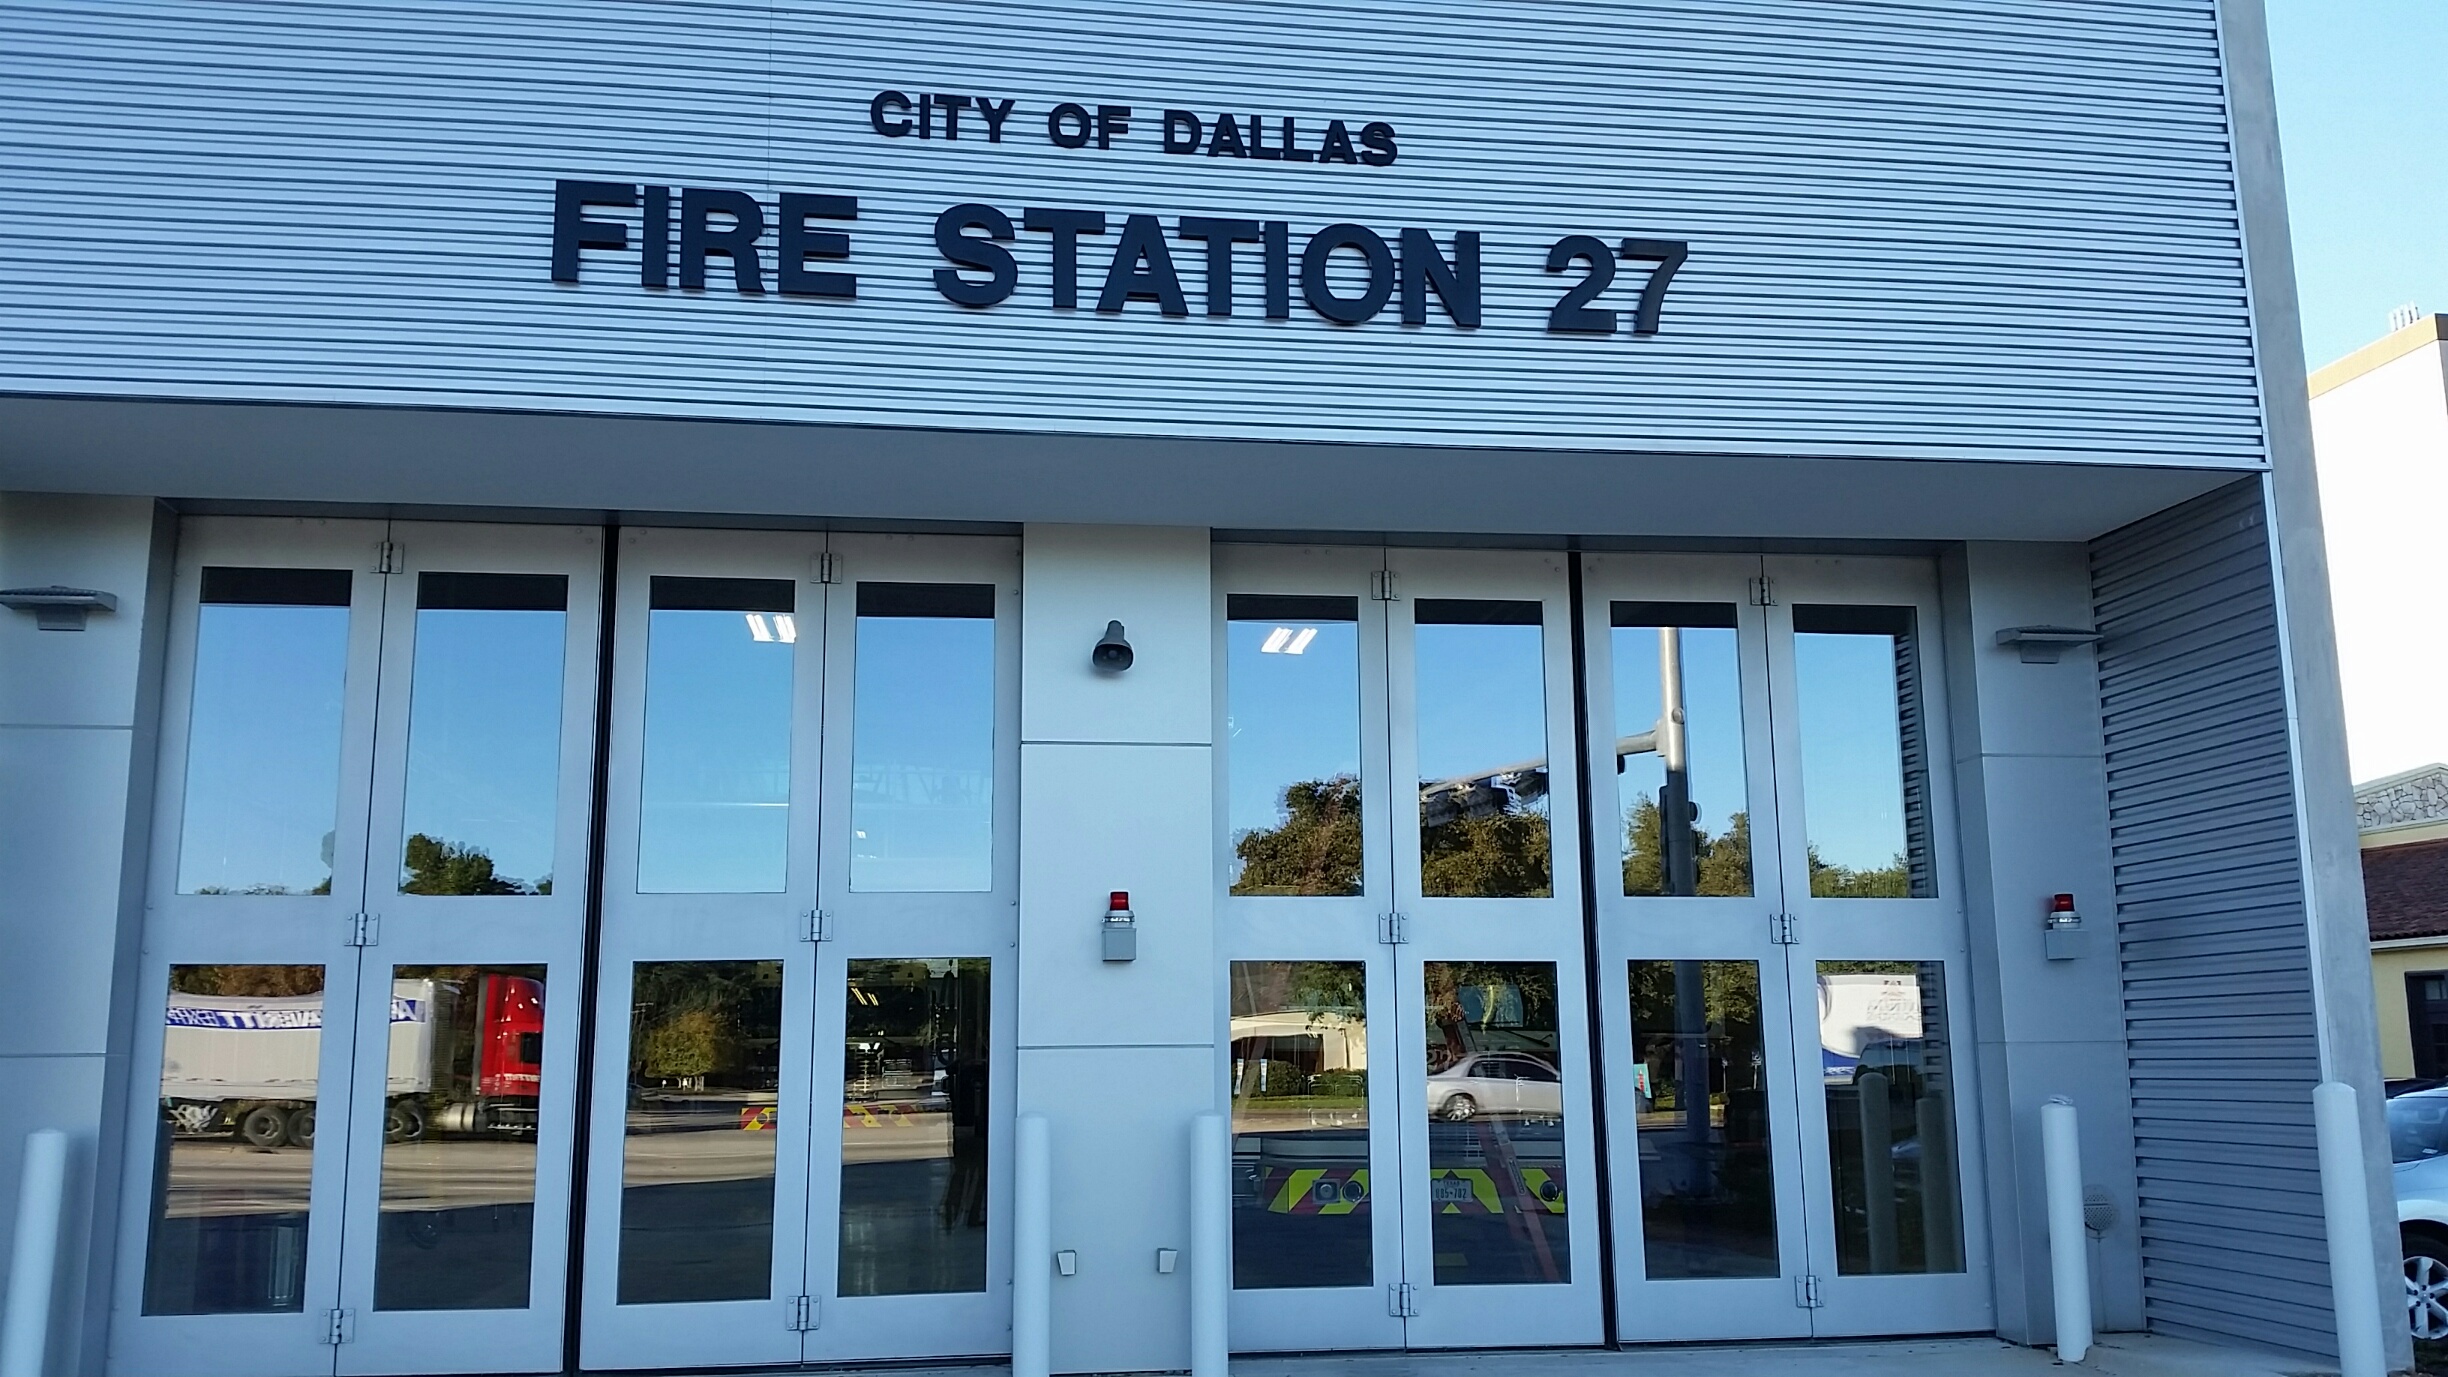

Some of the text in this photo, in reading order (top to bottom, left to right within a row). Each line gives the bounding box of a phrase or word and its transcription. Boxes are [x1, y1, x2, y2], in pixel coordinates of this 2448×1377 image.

[870, 90, 1398, 167] CITY OF DALLAS
[551, 179, 1688, 333] FIRE STATION 27
